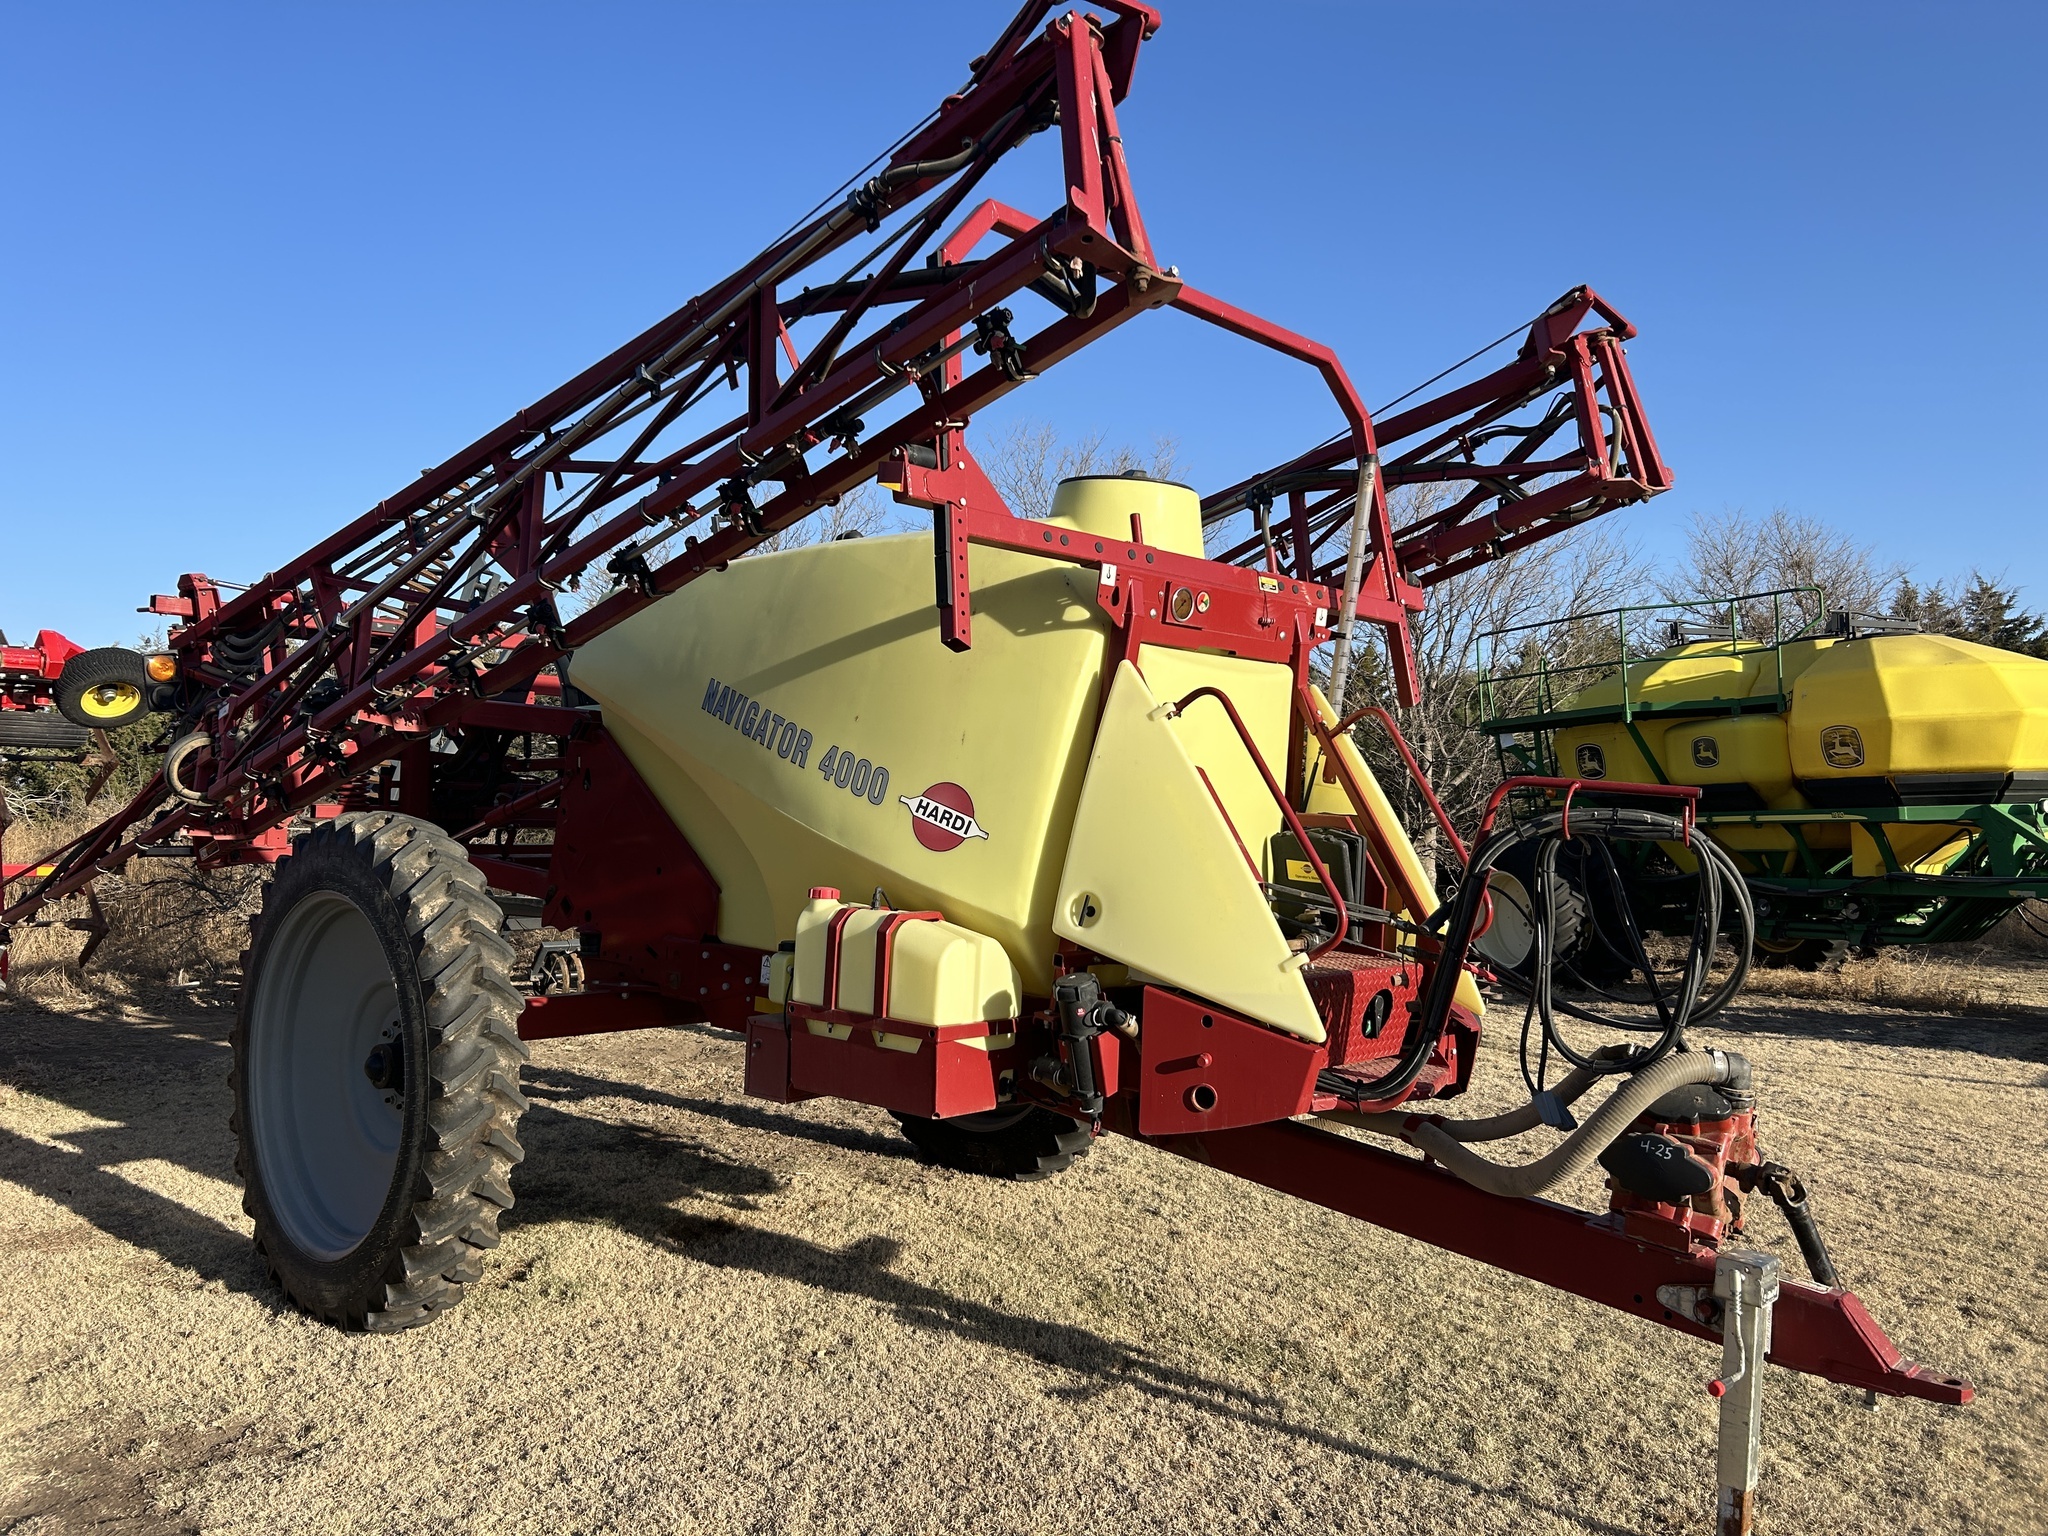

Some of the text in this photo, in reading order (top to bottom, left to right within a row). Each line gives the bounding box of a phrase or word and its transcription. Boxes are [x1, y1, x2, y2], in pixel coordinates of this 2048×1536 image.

[701, 678, 890, 806] NAVIGATOR 4000
[914, 799, 973, 835] HARDI
[1640, 1140, 1674, 1160] 4-25
